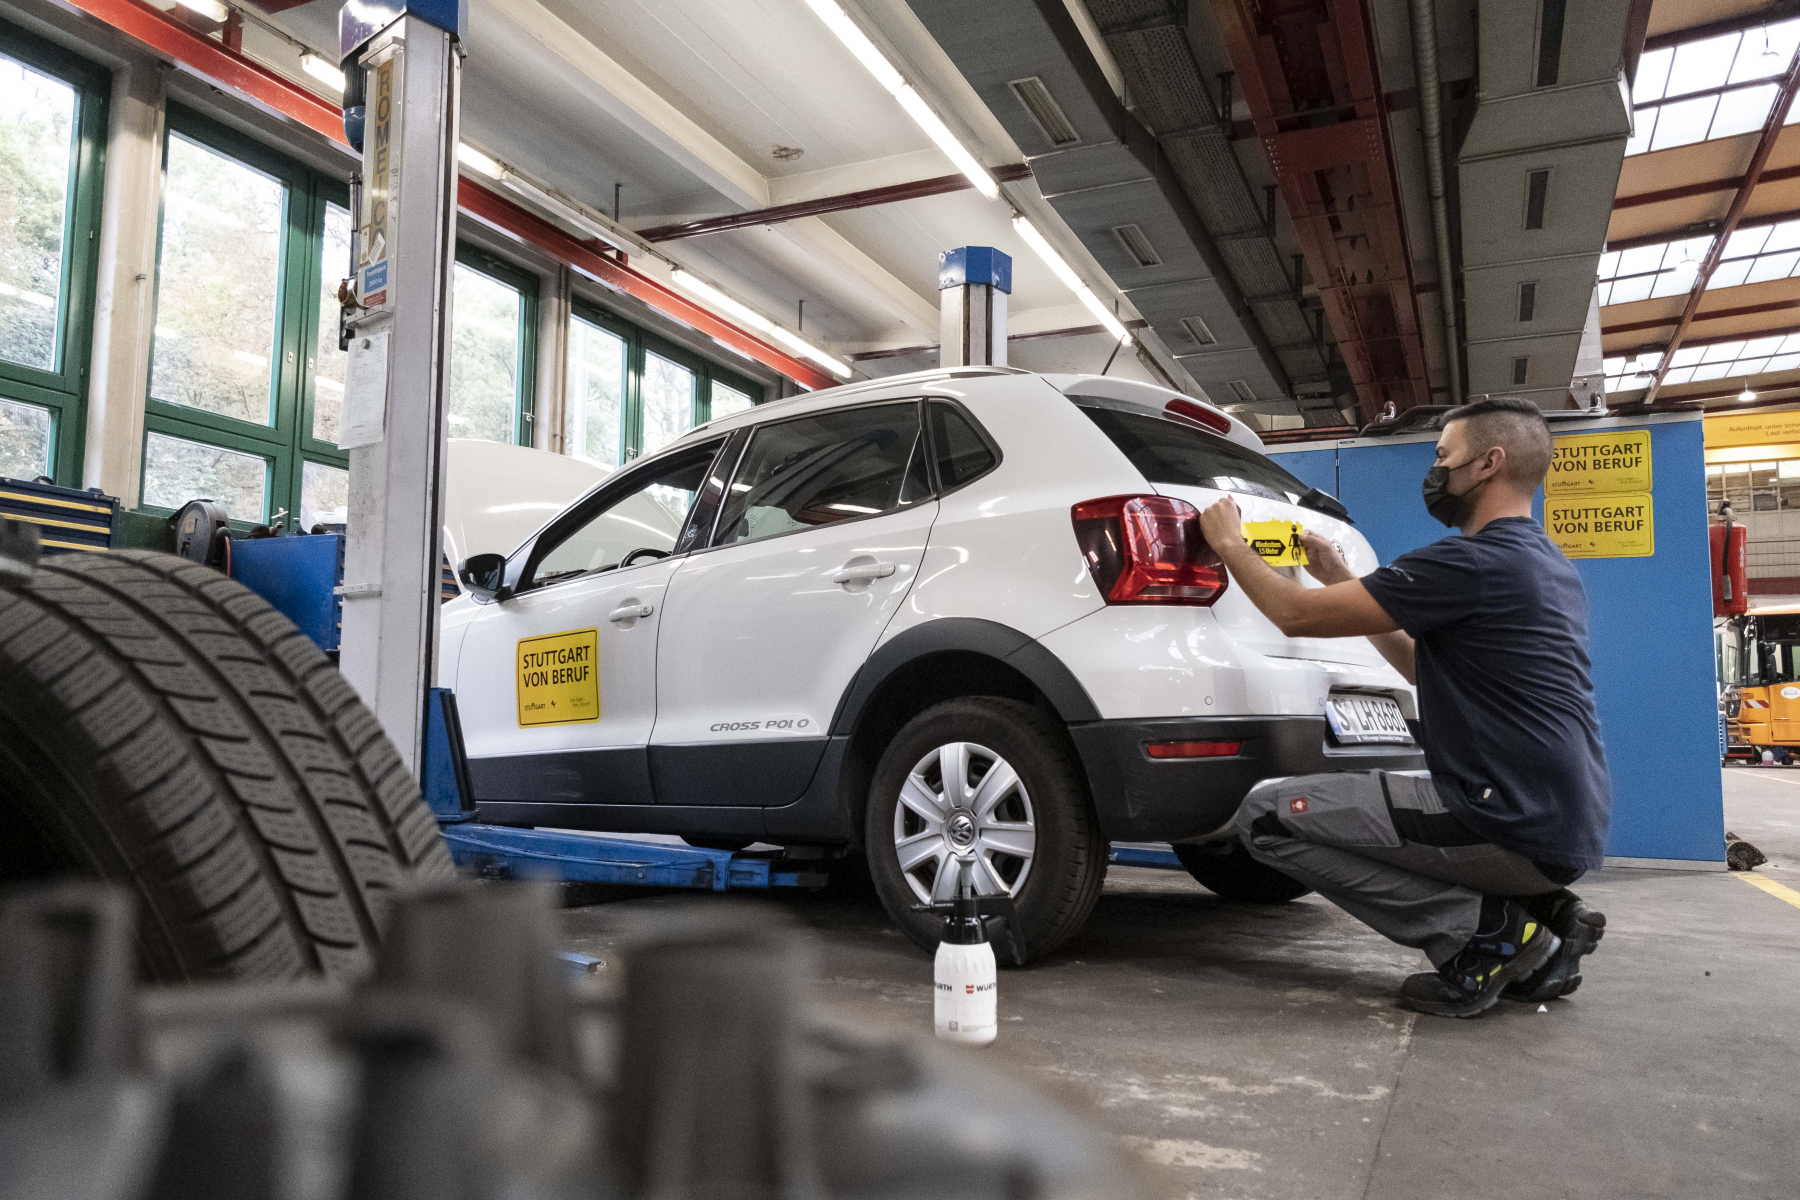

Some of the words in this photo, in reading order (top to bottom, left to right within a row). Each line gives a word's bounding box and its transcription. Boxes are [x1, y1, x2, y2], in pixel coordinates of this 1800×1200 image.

[1553, 443, 1643, 459] STUTTGART
[1552, 460, 1587, 472] VON
[1593, 457, 1643, 470] BERUF
[1552, 506, 1645, 521] STUTTGART
[1553, 522, 1588, 534] VON
[1594, 520, 1644, 533] BERUF
[523, 645, 590, 669] STUTTGART
[523, 670, 549, 688] VON
[552, 665, 589, 684] BERUF
[710, 721, 761, 732] CROSS
